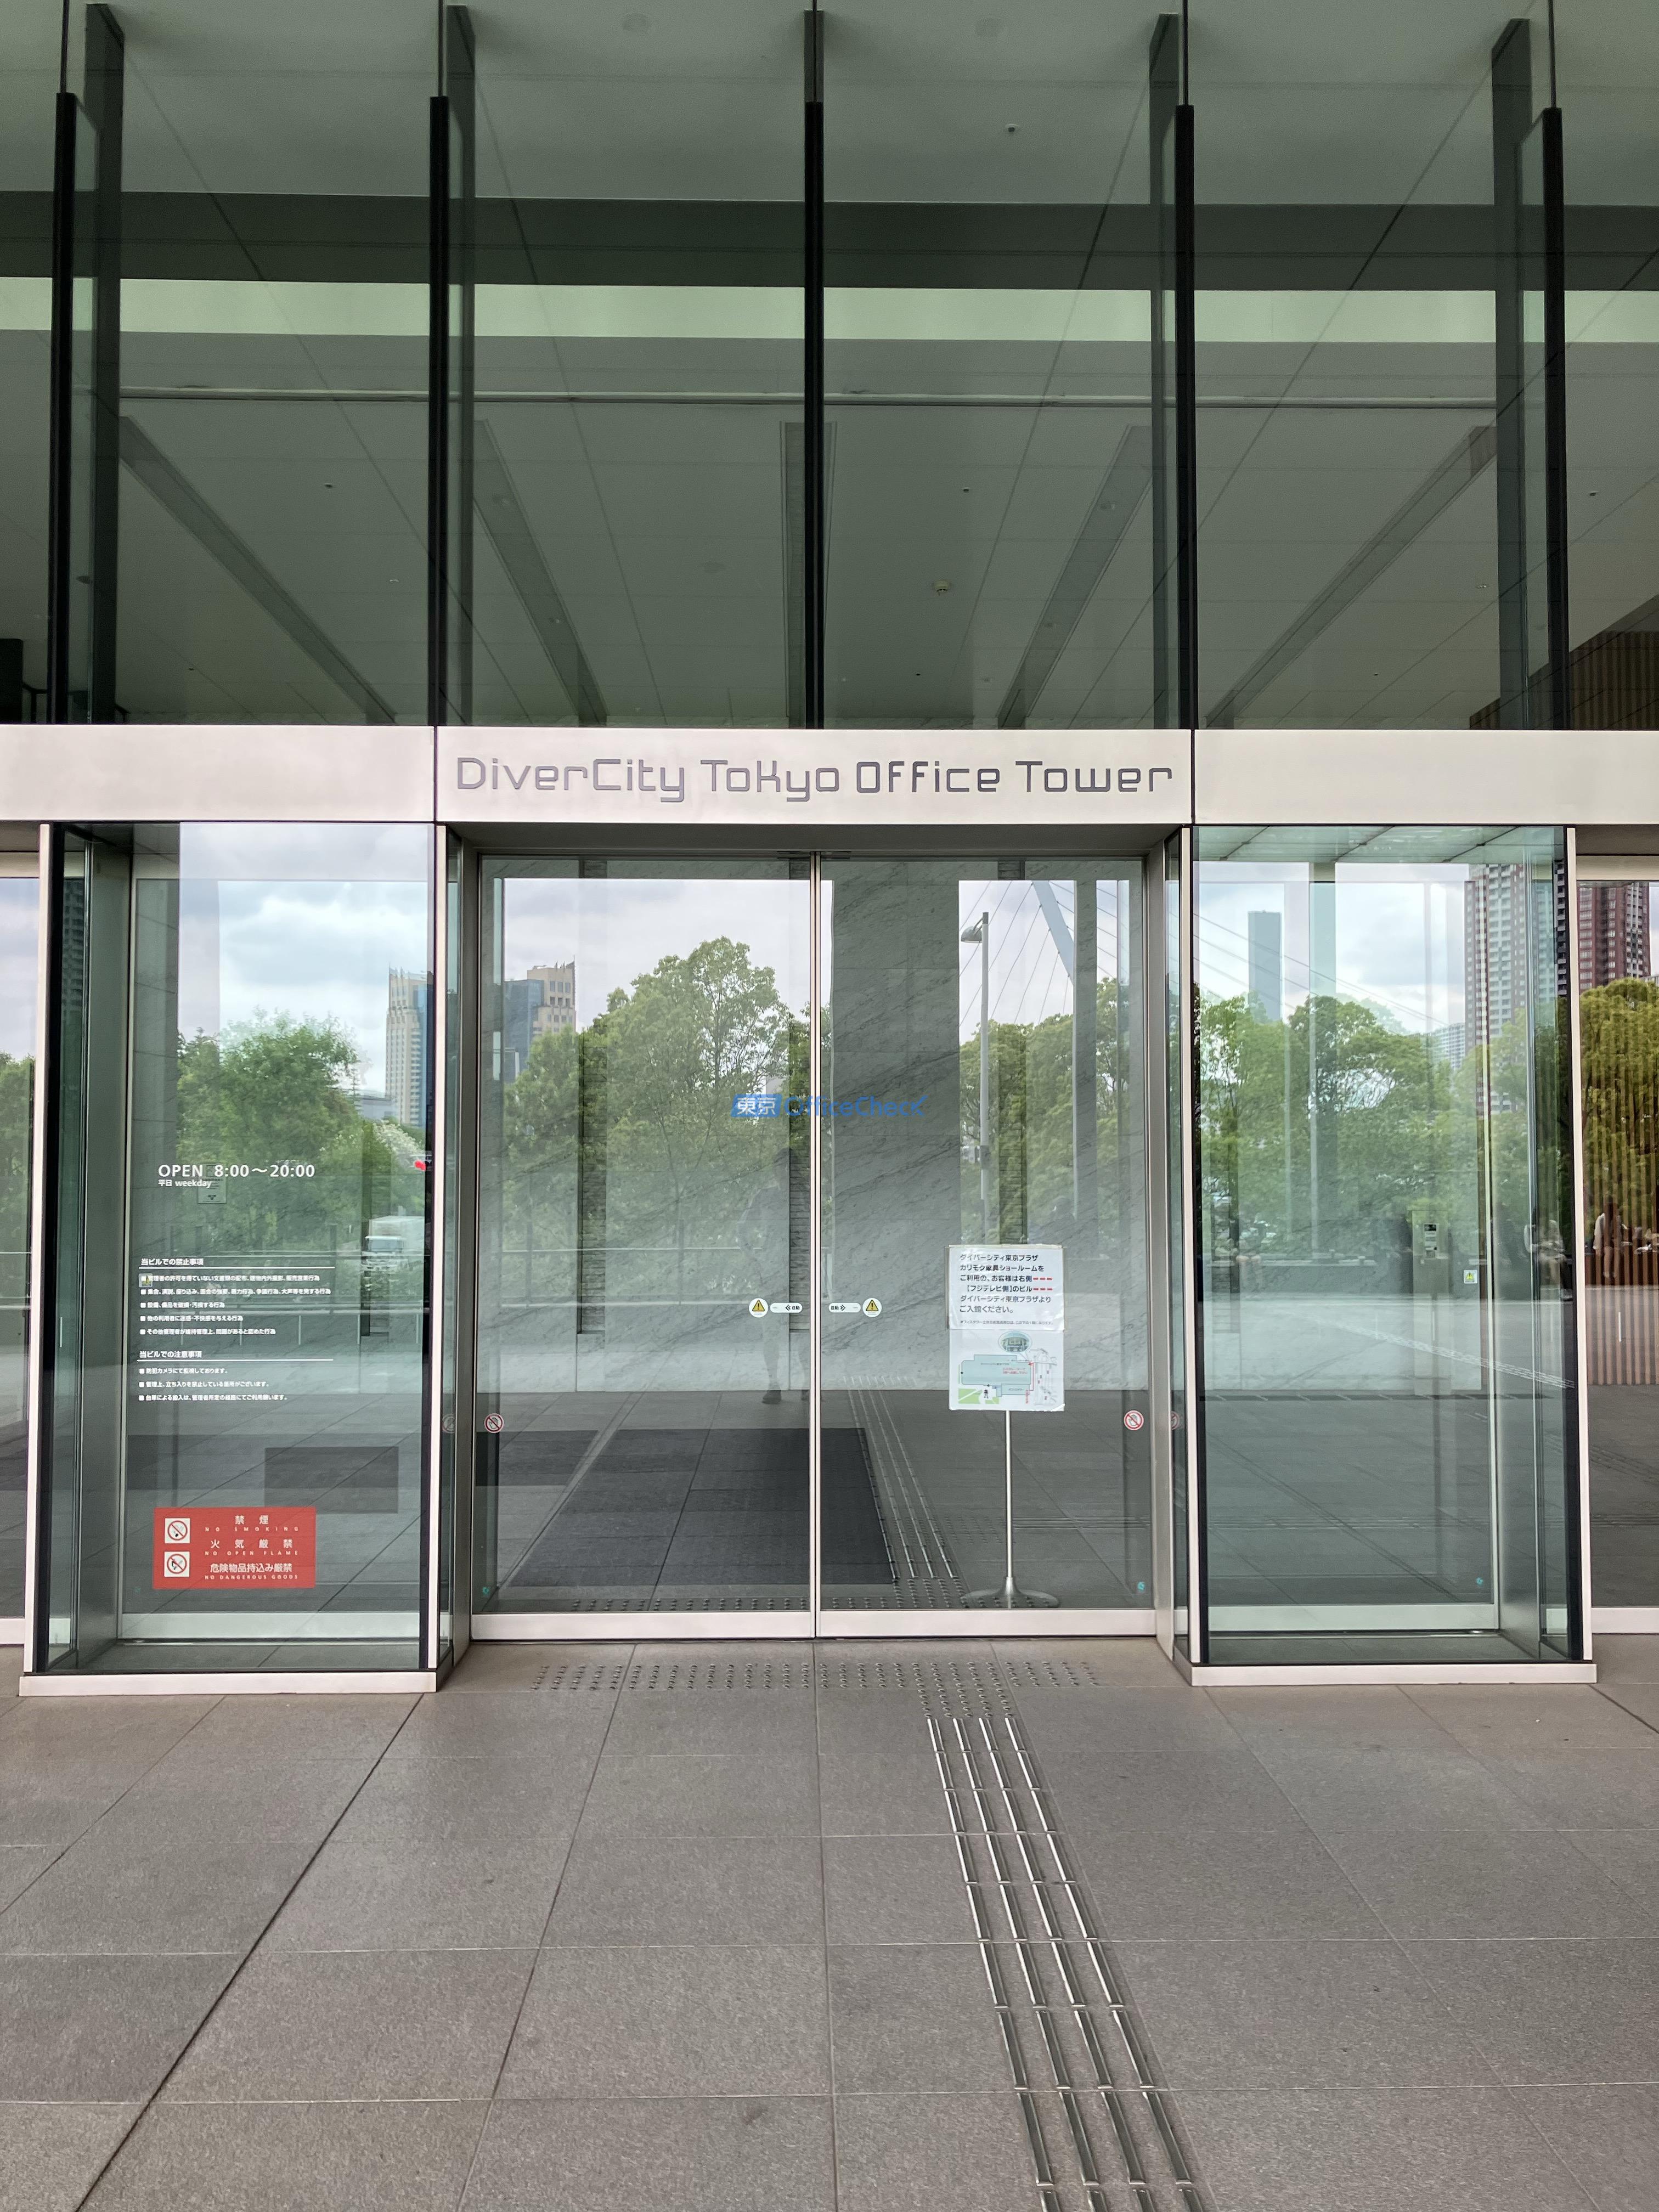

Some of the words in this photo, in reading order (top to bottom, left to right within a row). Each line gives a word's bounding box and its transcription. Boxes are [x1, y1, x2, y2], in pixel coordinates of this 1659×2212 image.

[457, 757, 685, 803] DiverCity
[1015, 760, 1172, 793] Tower
[158, 1164, 203, 1177] OPEN
[175, 1179, 212, 1189] weekday
[139, 1350, 202, 1358] 当ビルでの注意事項
[235, 1515, 269, 1525] 禁煙
[210, 1563, 293, 1573] 危険物品持込み厳禁
